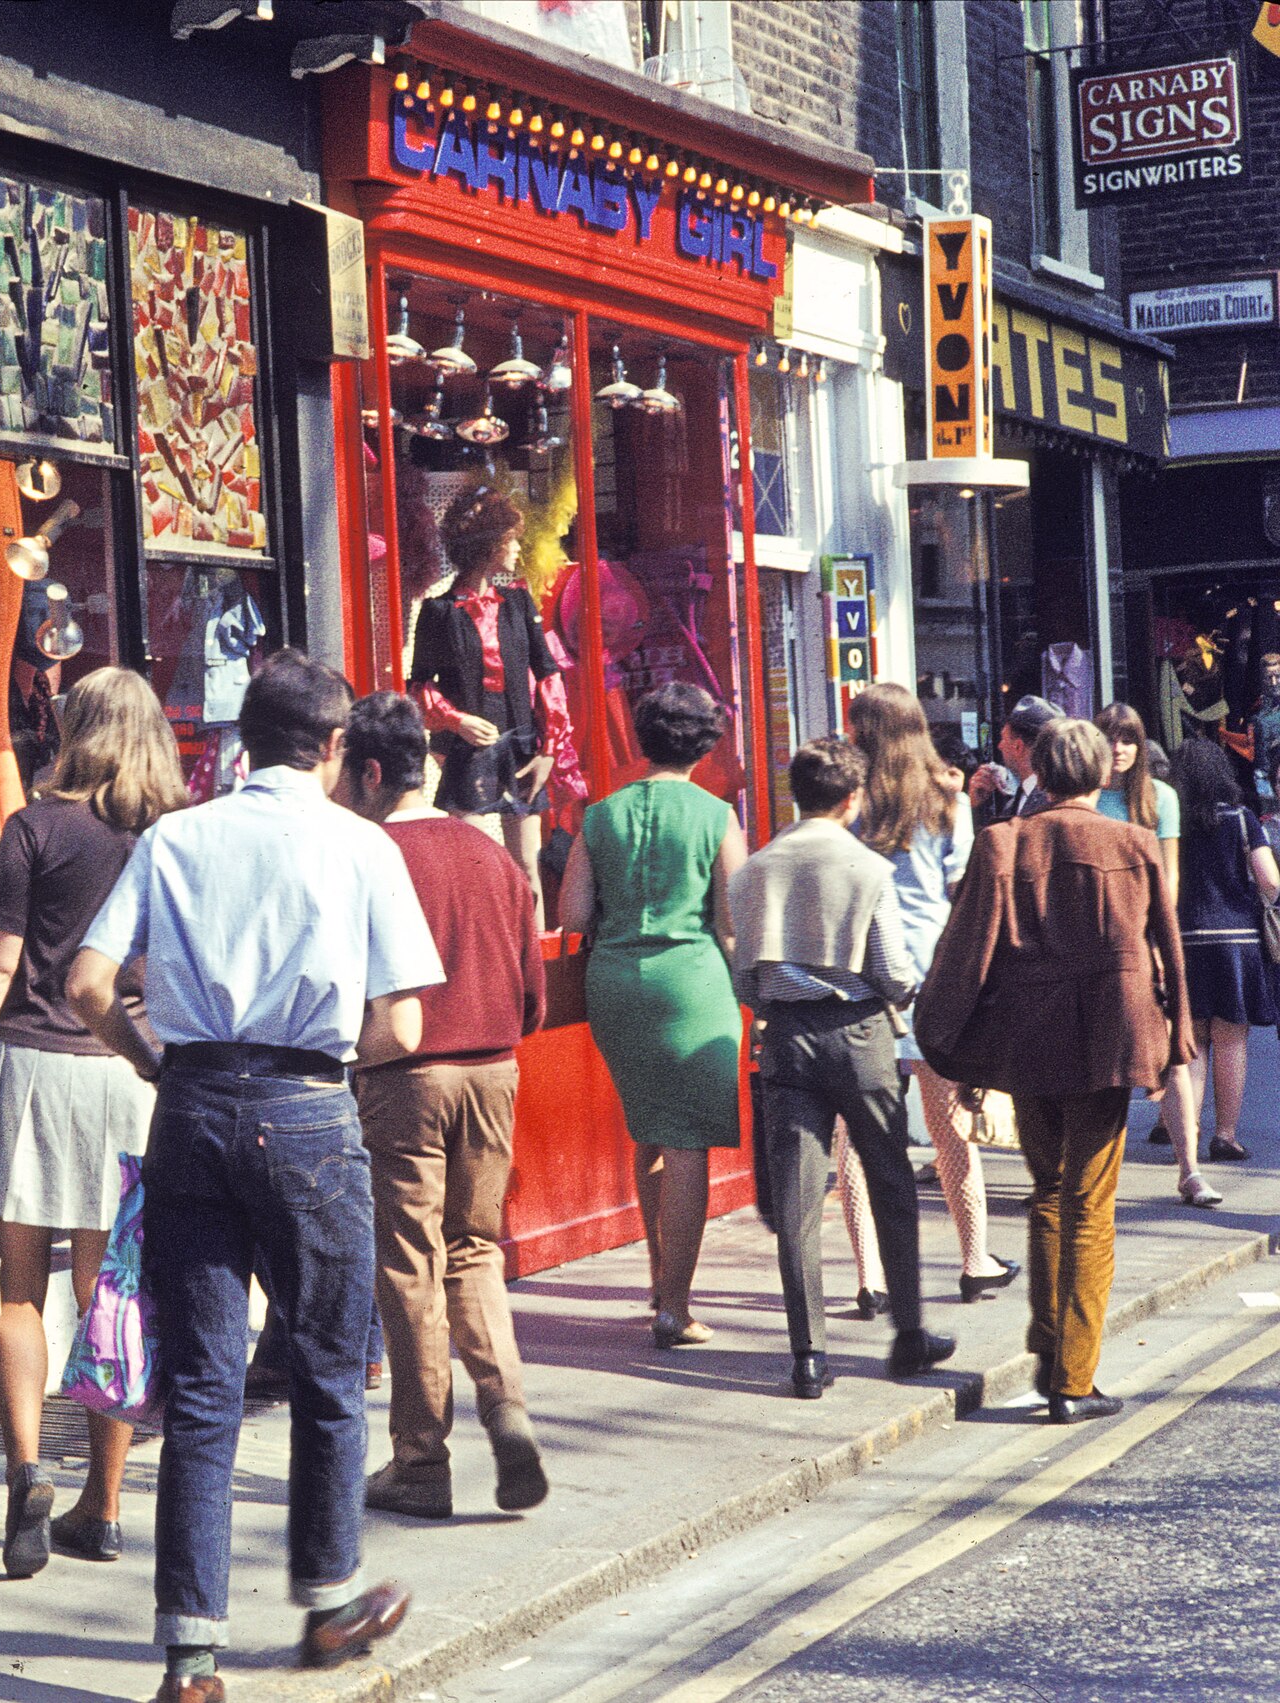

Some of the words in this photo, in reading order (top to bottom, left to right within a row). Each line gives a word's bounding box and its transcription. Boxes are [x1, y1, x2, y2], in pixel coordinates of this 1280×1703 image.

[1087, 66, 1227, 106] CARNABY
[1089, 96, 1232, 156] SIGNS
[393, 91, 661, 239] CARNABY
[679, 187, 777, 278] GIRL
[1083, 154, 1243, 194] SIGNWRITERS
[935, 231, 971, 422] YVON
[1135, 298, 1221, 329] MARLBOROUGH
[1225, 294, 1263, 319] COURT
[992, 301, 1128, 443] ATES
